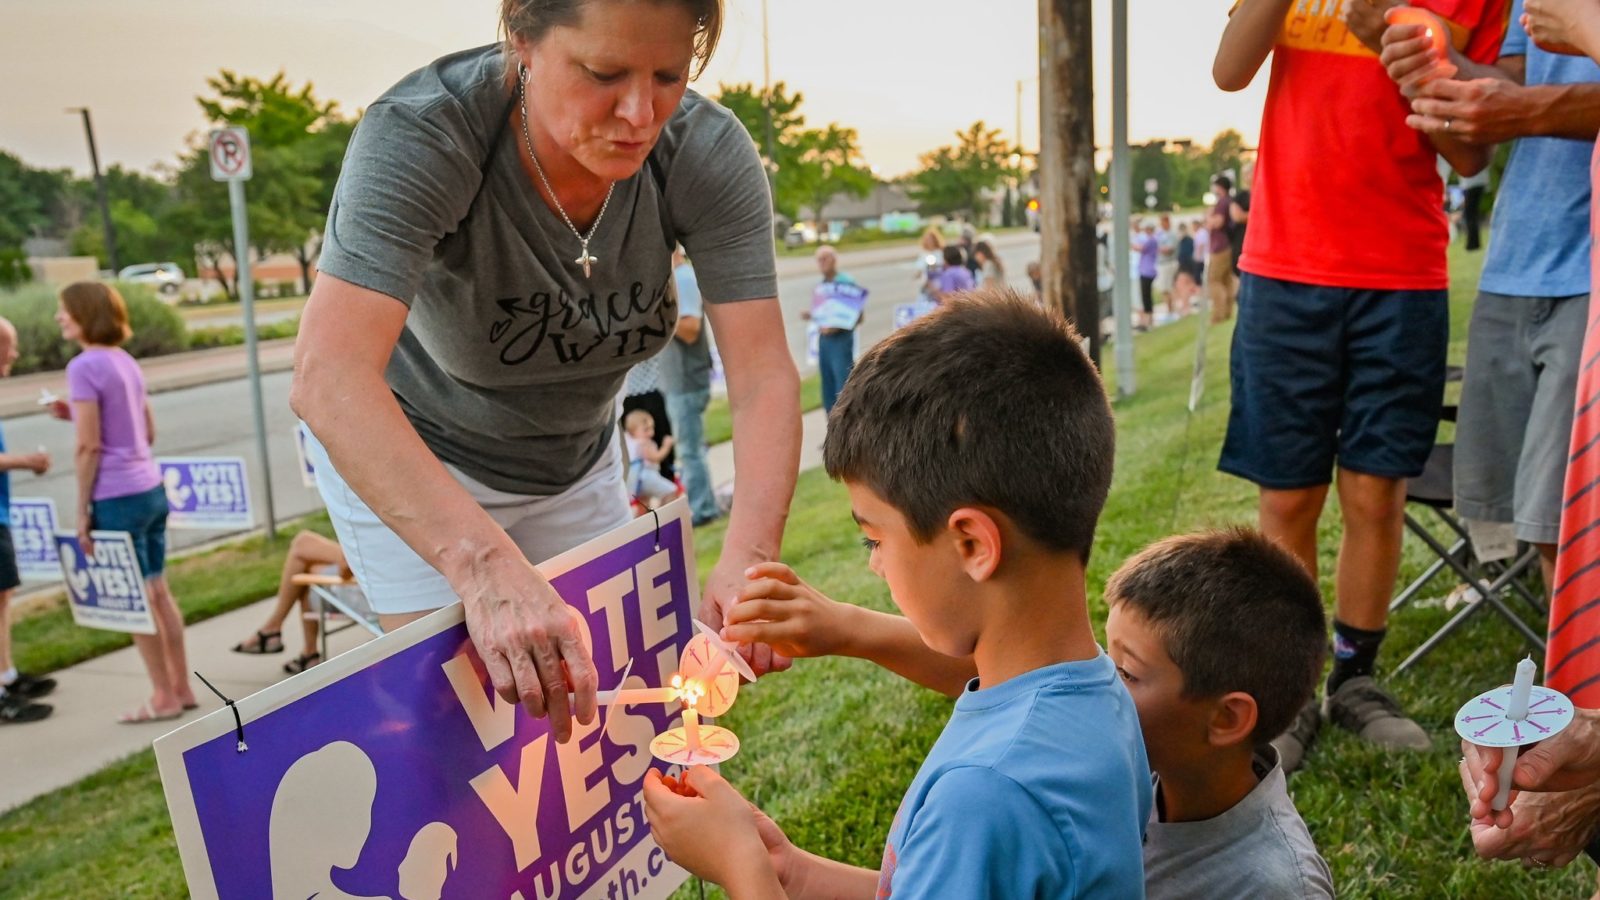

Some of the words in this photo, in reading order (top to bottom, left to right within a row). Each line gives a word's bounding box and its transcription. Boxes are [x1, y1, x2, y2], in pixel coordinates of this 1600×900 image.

[548, 305, 677, 363] WIN
[188, 465, 240, 483] VOTE
[192, 483, 245, 505] YES!
[86, 567, 141, 597] YES!
[441, 548, 679, 752] VTE
[469, 643, 692, 873] YES!
[510, 787, 652, 900] UGUST
